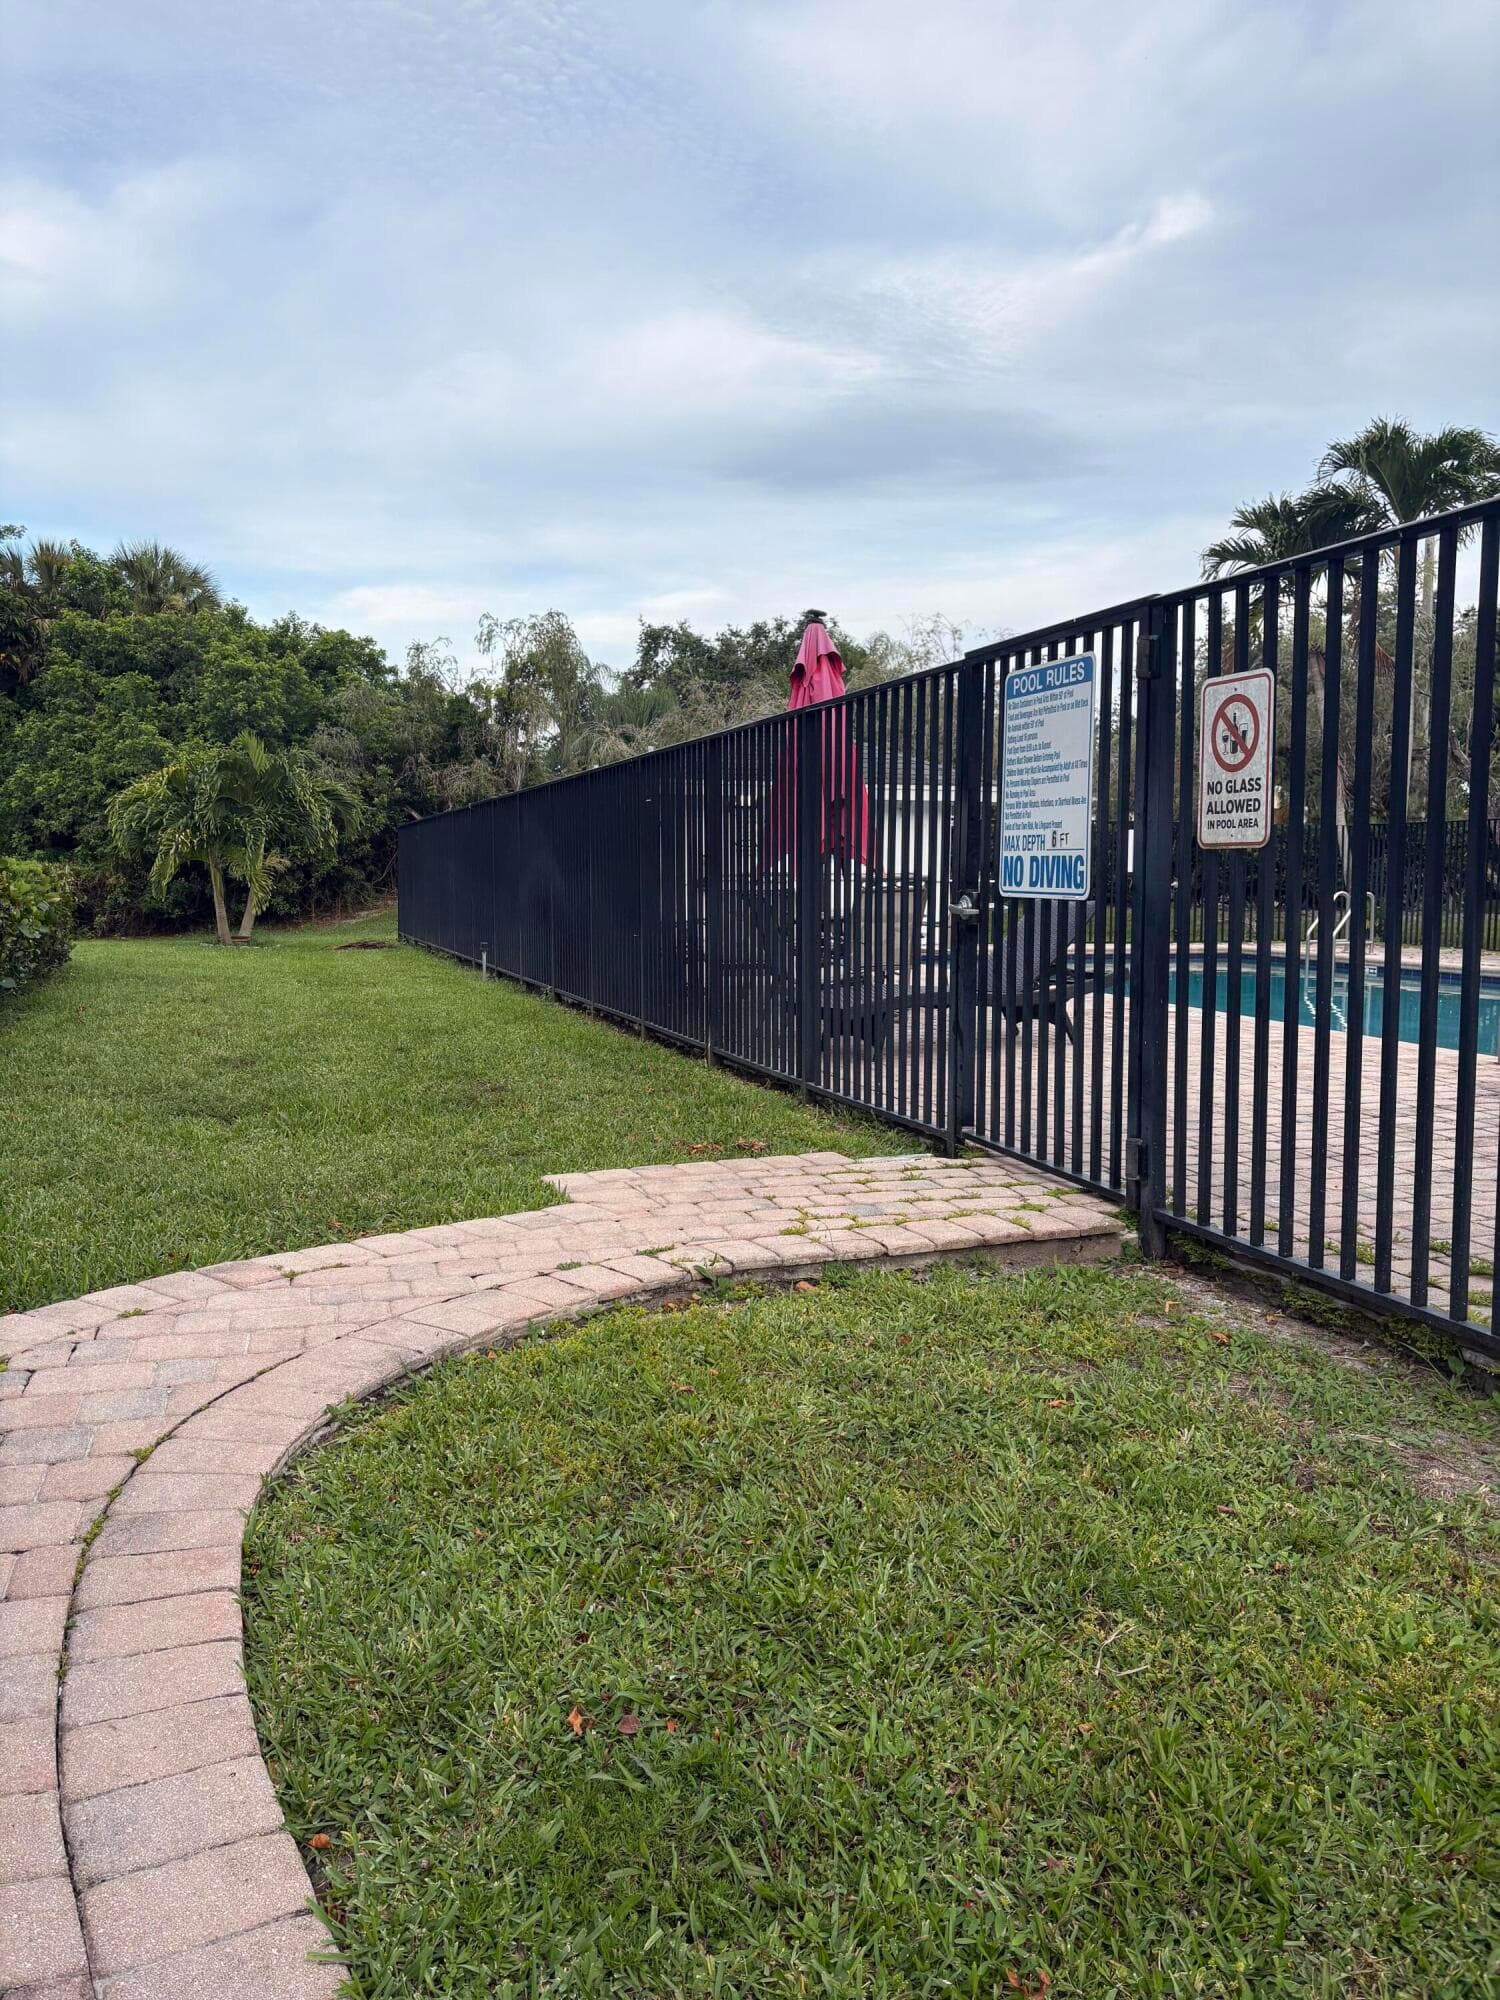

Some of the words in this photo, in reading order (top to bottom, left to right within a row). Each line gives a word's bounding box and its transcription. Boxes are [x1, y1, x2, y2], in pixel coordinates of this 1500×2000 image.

[1013, 672, 1043, 695] POOL
[1046, 661, 1085, 687] RULES
[1207, 781, 1222, 795] NO
[1225, 777, 1262, 794] GLASS
[1206, 798, 1261, 815] ALLOWED
[1207, 820, 1215, 830] IN
[1216, 819, 1236, 829] POOL
[1238, 818, 1259, 829] AREA
[1004, 835, 1020, 851] MAX
[1022, 834, 1045, 851] DEPTH
[1052, 830, 1057, 847] 6
[1060, 832, 1070, 847] FT
[1003, 855, 1024, 887] NO
[1029, 855, 1085, 889] DIVING
